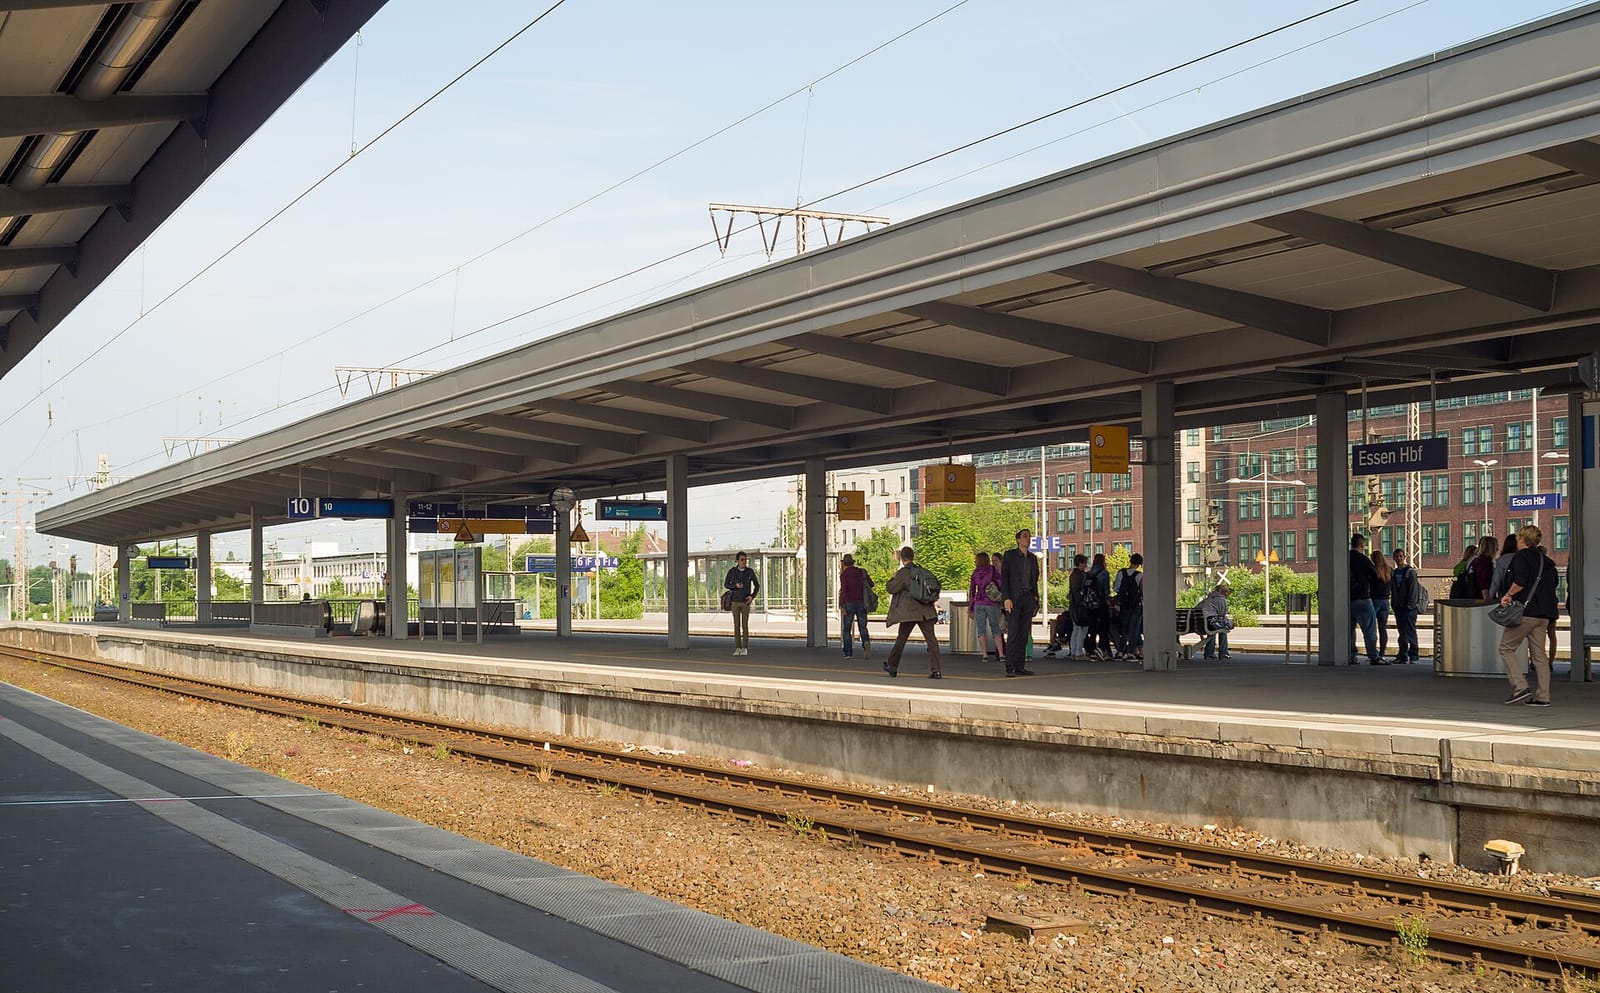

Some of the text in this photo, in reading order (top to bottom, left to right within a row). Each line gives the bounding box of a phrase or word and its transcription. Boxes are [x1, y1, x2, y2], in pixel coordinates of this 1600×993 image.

[1358, 445, 1423, 466] Essen Hbf
[291, 498, 310, 514] 10
[323, 502, 333, 511] 10
[1512, 496, 1546, 507] Essen Hbf
[1030, 537, 1037, 549] E
[1053, 537, 1060, 549] E
